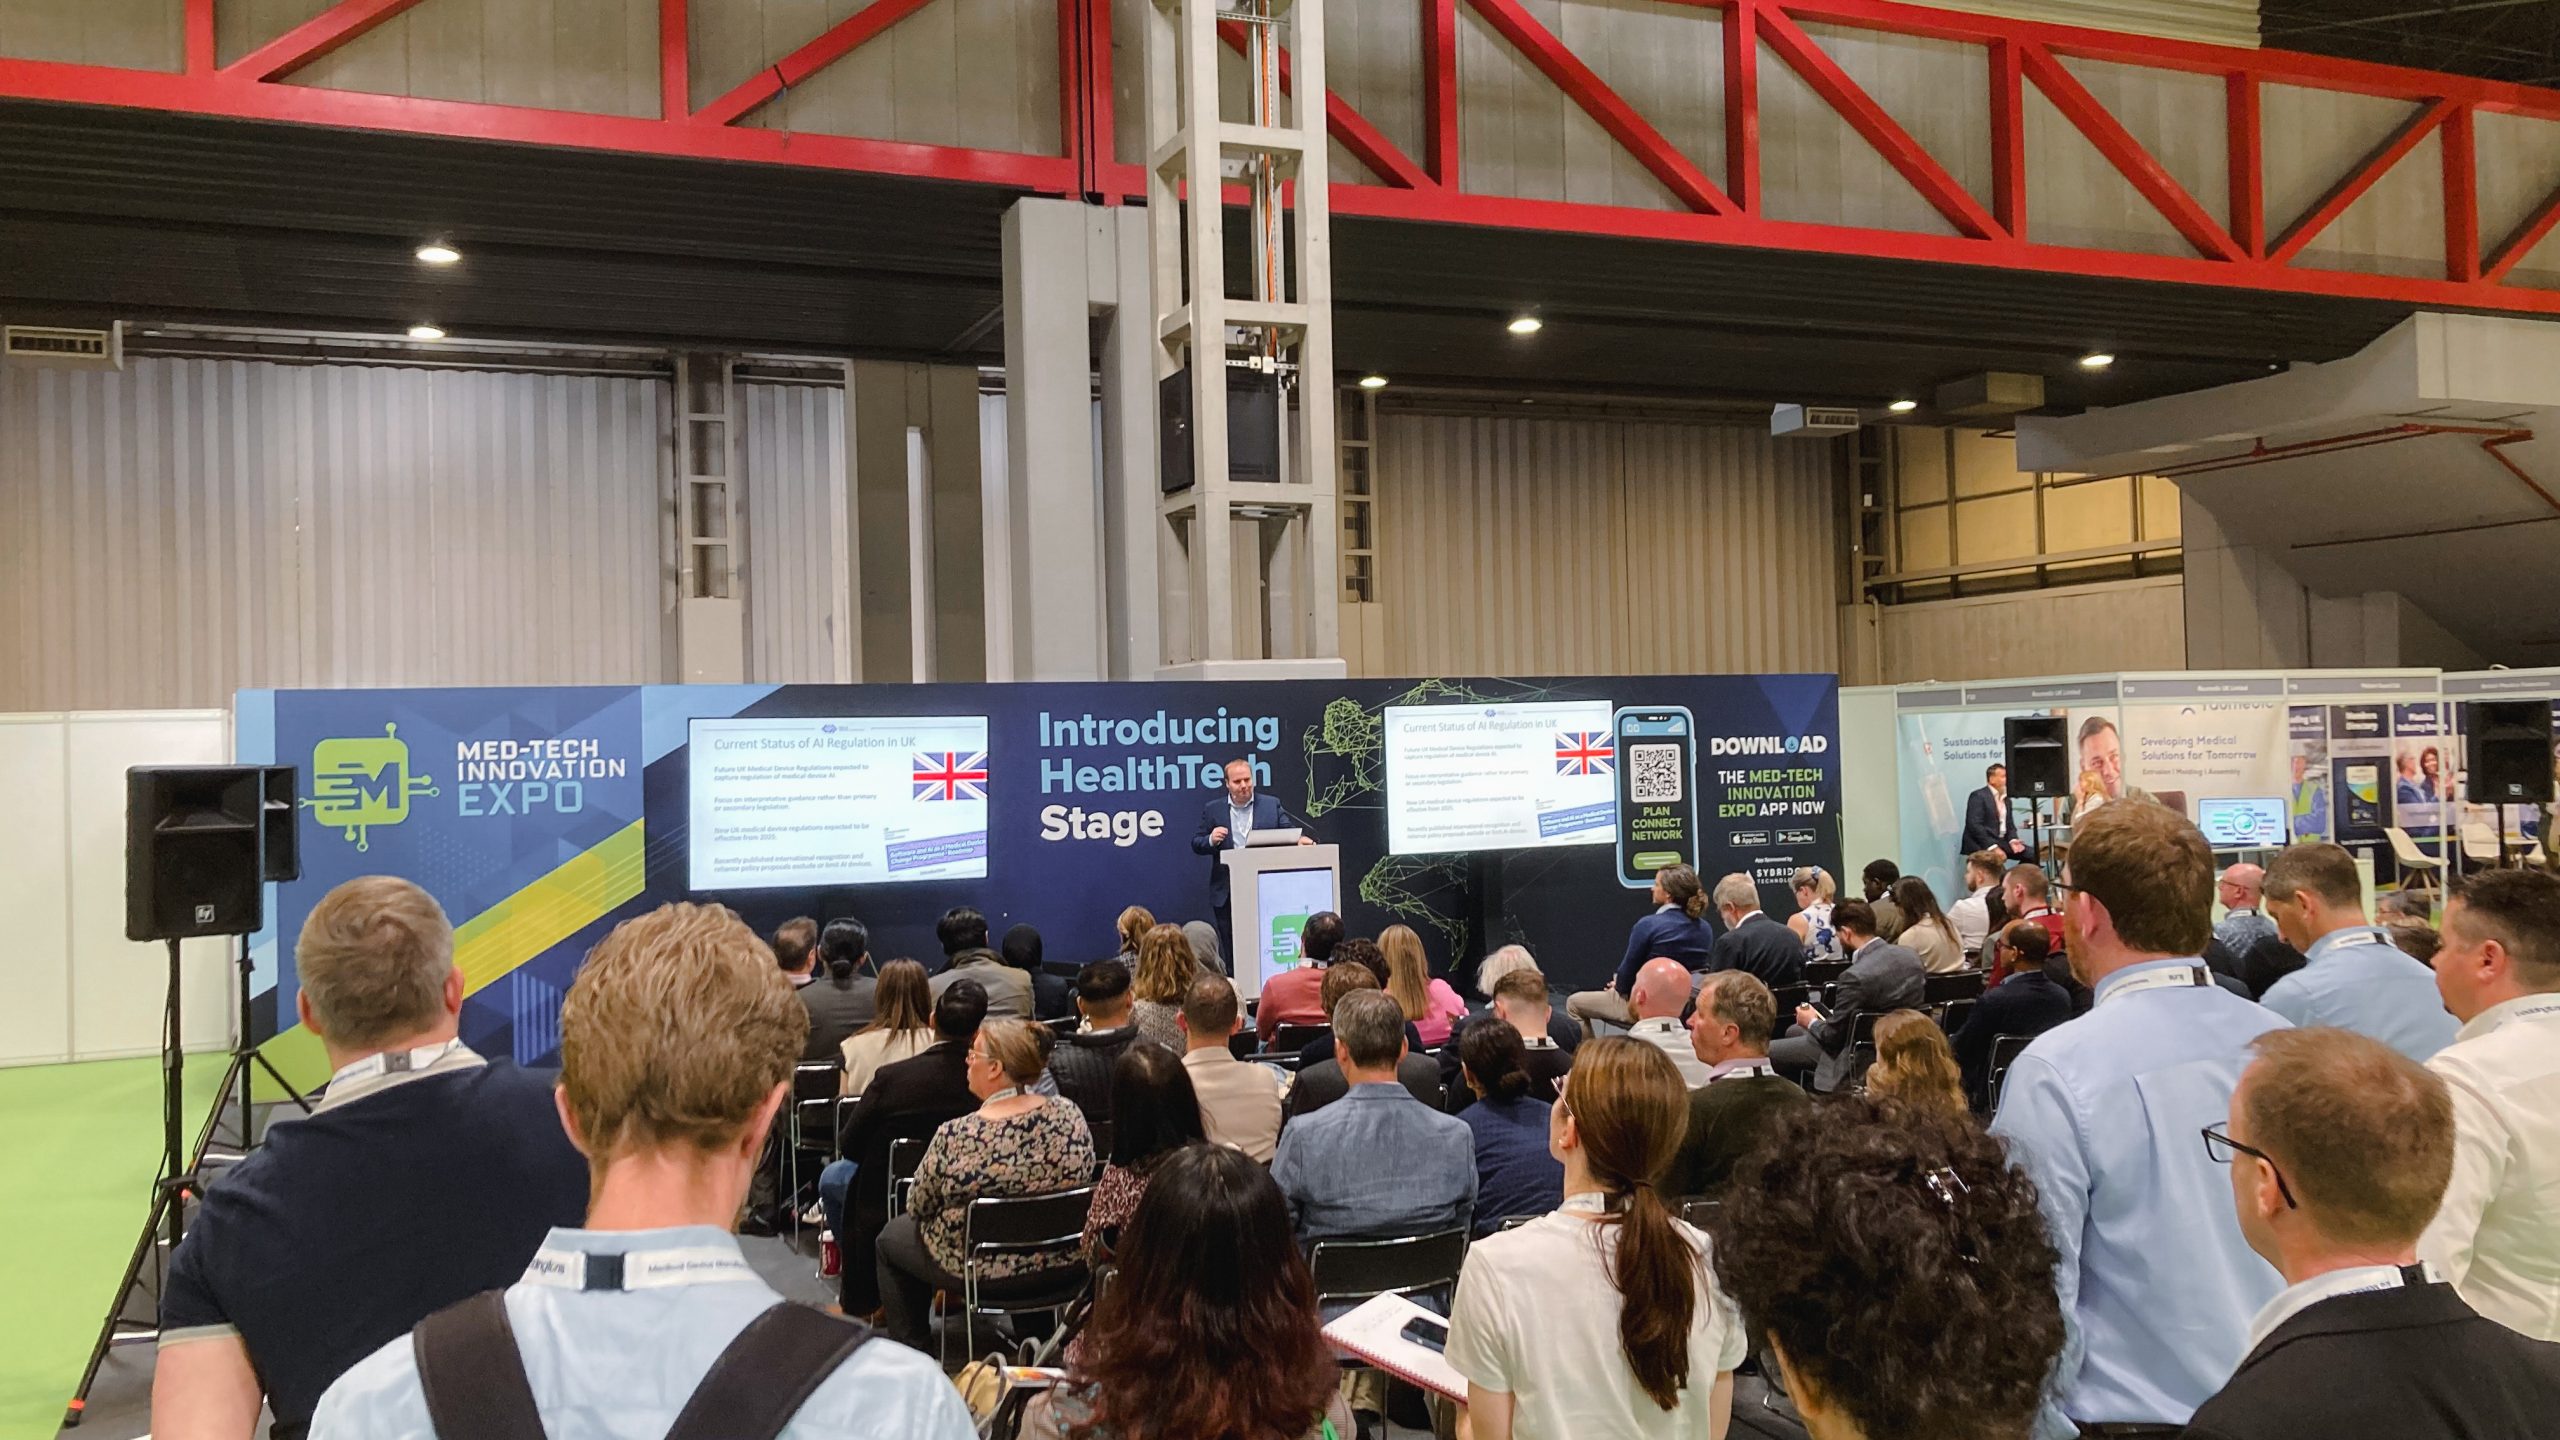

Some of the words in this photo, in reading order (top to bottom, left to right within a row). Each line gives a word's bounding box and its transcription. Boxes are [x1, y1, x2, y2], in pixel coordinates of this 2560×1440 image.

[1039, 707, 1279, 750] Introducing
[1403, 723, 1436, 733] Current
[1439, 722, 1465, 732] Status
[1467, 721, 1476, 731] of
[1478, 721, 1487, 730] AI
[1489, 720, 1533, 732] Regulation
[714, 738, 758, 750] Current
[761, 738, 795, 749] Status
[798, 737, 810, 748] of
[813, 738, 824, 748] AI
[827, 737, 884, 750] Regulation
[888, 737, 897, 747] in
[901, 736, 916, 747] UK
[1944, 736, 1998, 748] Sustainable
[2142, 737, 2194, 748] Developing
[2196, 736, 2237, 745] Medical
[457, 739, 599, 761] MED-TECH
[1944, 751, 1986, 761] Solutions
[1988, 751, 2002, 759] for
[2142, 751, 2185, 760] Solutions
[2188, 751, 2202, 760] for
[2206, 750, 2257, 760] Tomorrow
[457, 758, 626, 782] INNOVATION
[1040, 754, 1272, 794] HealthTeh
[1718, 770, 1745, 784] THE
[1749, 768, 1823, 783] MED-TECH
[458, 780, 584, 817] EXPO
[1728, 785, 1815, 800] INNOVATION
[1643, 806, 1670, 816] PLAN
[1718, 803, 1756, 818] EXPO
[1759, 802, 1788, 816] APP
[1792, 801, 1825, 815] NOW
[1040, 805, 1165, 847] Stage
[1632, 817, 1682, 829] CONNECT
[1632, 830, 1683, 841] NETWORK
